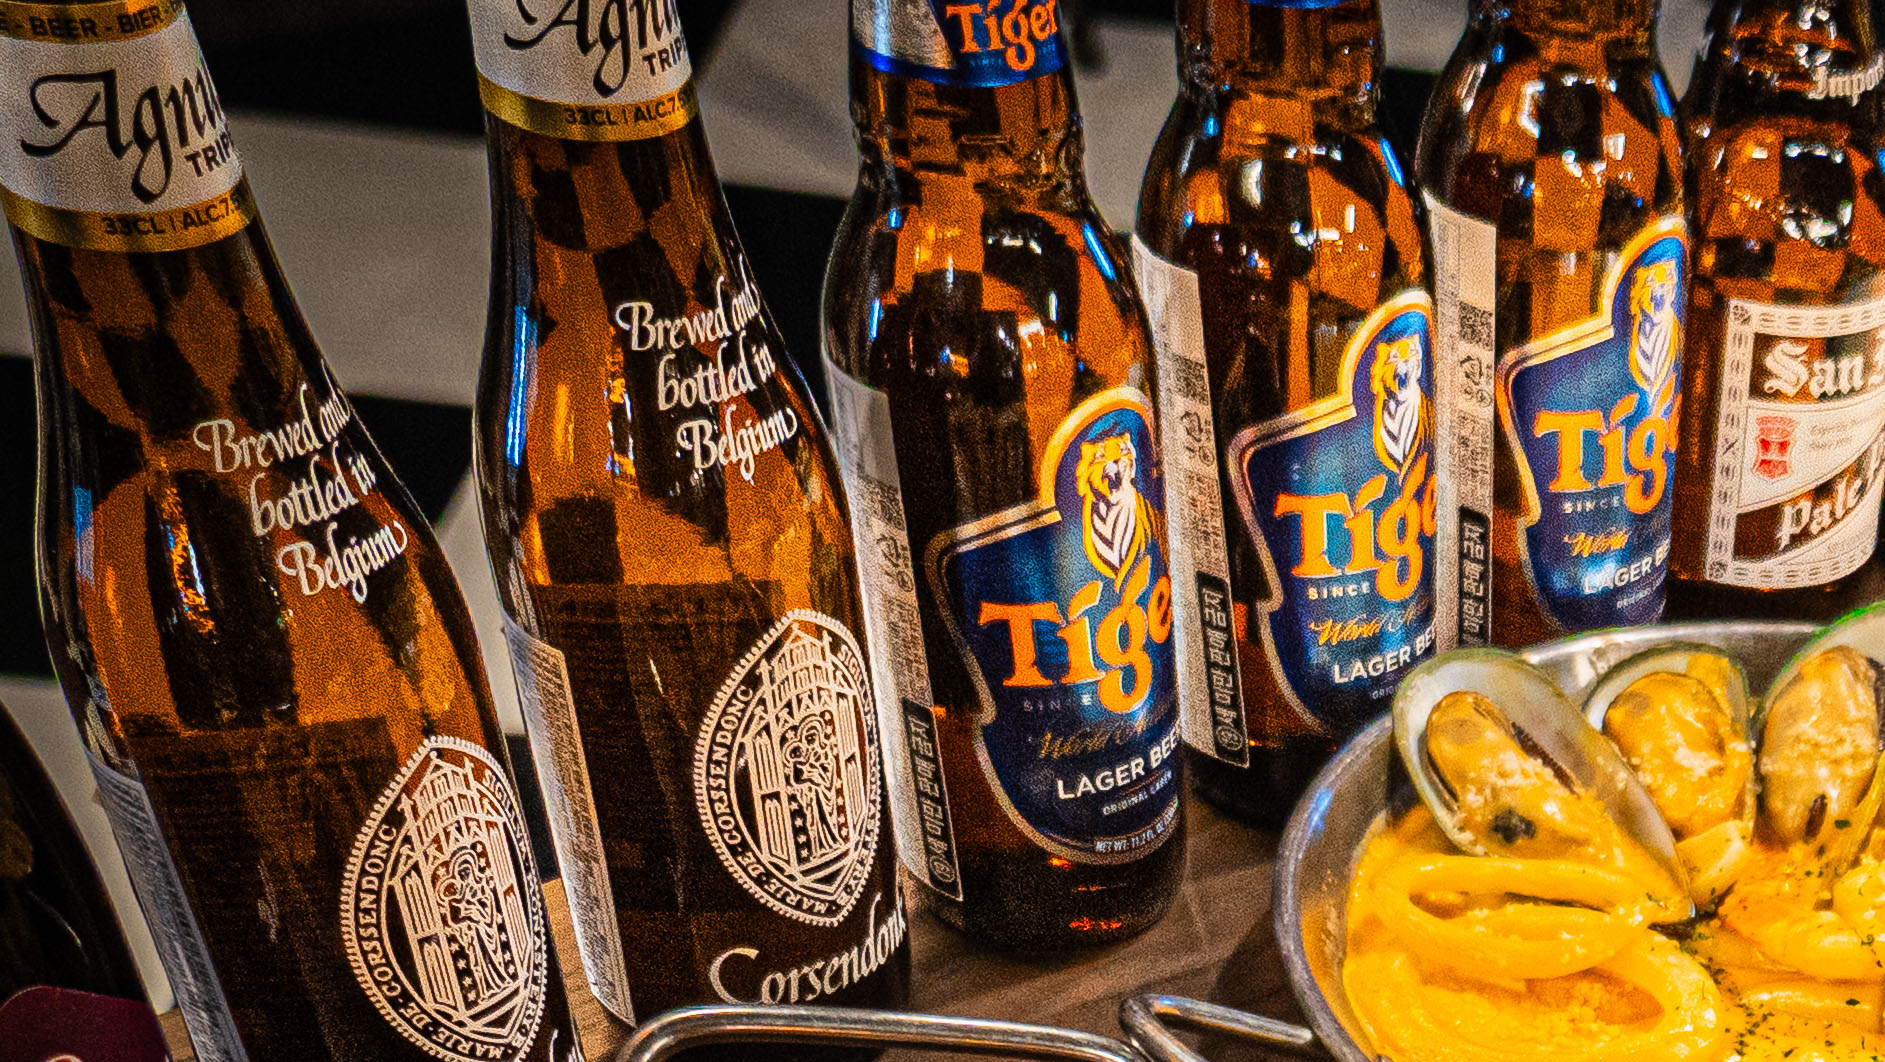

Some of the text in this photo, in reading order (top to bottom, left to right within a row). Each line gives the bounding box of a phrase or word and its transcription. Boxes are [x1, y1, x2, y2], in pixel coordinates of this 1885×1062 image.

[29, 15, 99, 39] BEER
[117, 5, 165, 35] BIER
[641, 34, 688, 77] TRIP
[184, 121, 235, 178] TRIP
[615, 275, 733, 351] Brewed
[658, 330, 776, 411] bottled in
[1763, 340, 1865, 399] San
[193, 381, 323, 474] Brewed
[677, 404, 798, 486] Belgium
[250, 441, 377, 537] bottled in
[276, 520, 408, 604] Belgium
[1582, 556, 1653, 595] LAGER
[1201, 587, 1228, 628] 금지
[1306, 580, 1371, 601] SINCE
[977, 556, 1173, 714] Tige
[1205, 627, 1232, 668] 판매
[1209, 667, 1235, 705] 미만
[1332, 645, 1401, 684] LAGER
[907, 714, 935, 758] 금지
[709, 685, 754, 846] CORSSENDONC
[913, 754, 940, 798] 판매
[1057, 757, 1146, 800] LAGER
[1150, 719, 1182, 770] BEE
[918, 796, 946, 836] 미만
[736, 851, 766, 878] DE
[357, 824, 402, 997] CORSSENDONC
[763, 877, 830, 914] MARIE
[398, 1001, 433, 1031] DE
[431, 1026, 505, 1060] MARIE
